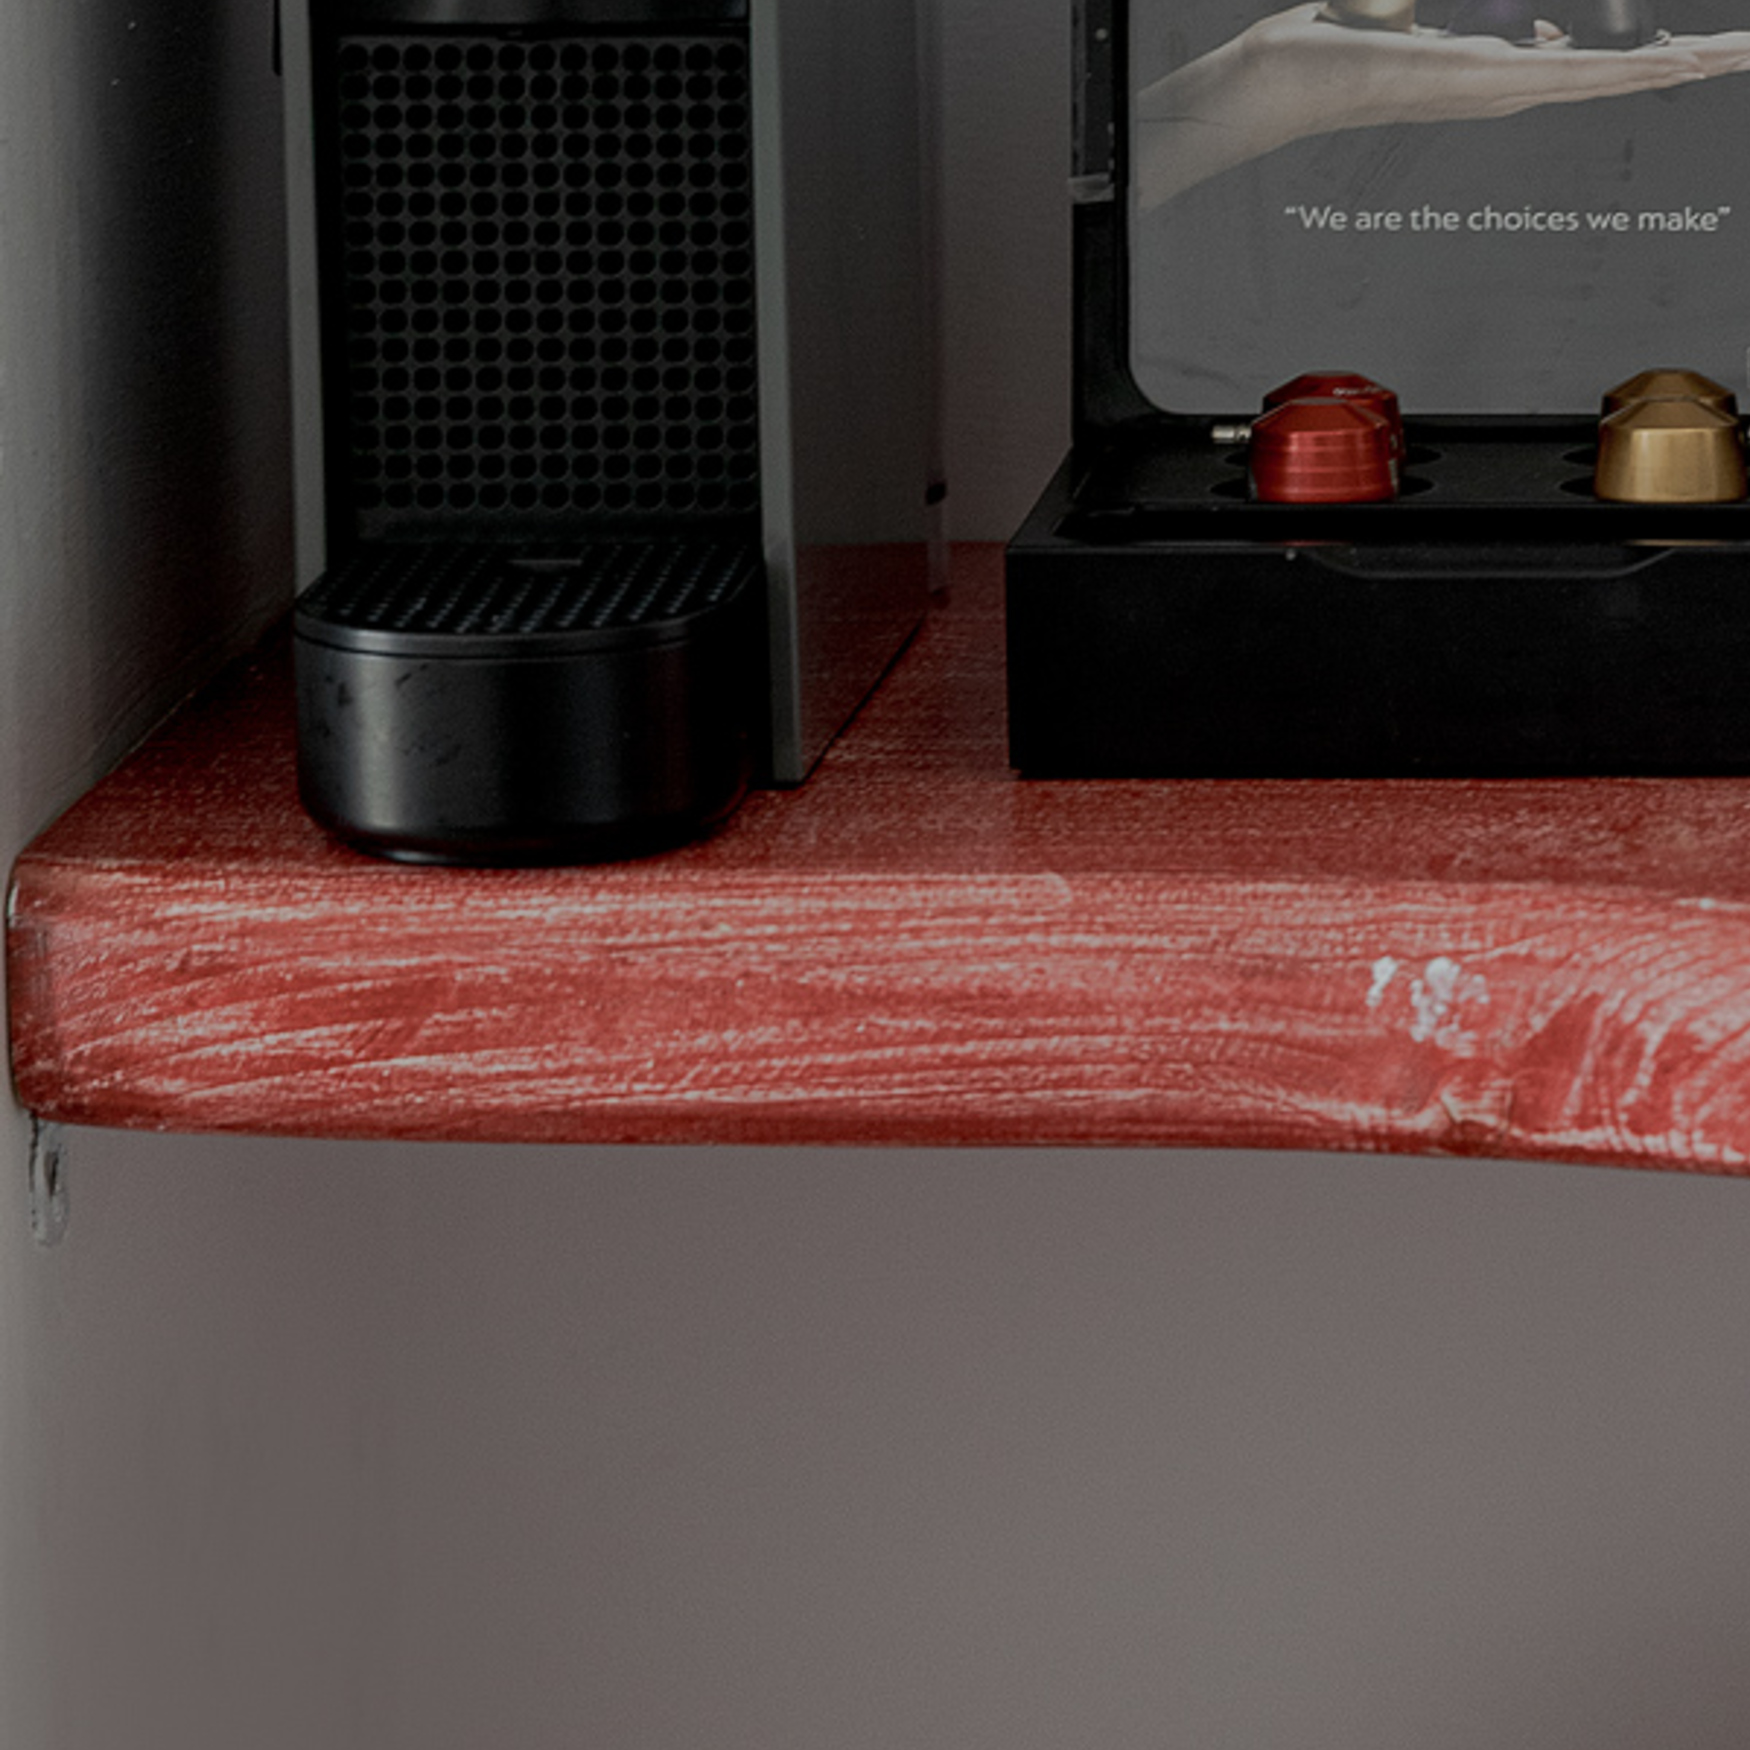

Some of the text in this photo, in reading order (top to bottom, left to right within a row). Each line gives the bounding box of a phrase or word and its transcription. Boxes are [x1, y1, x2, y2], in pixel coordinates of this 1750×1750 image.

[1355, 211, 1403, 231] are
[1410, 204, 1460, 231] the
[1467, 204, 1579, 231] choices
[1586, 211, 1628, 231] we
